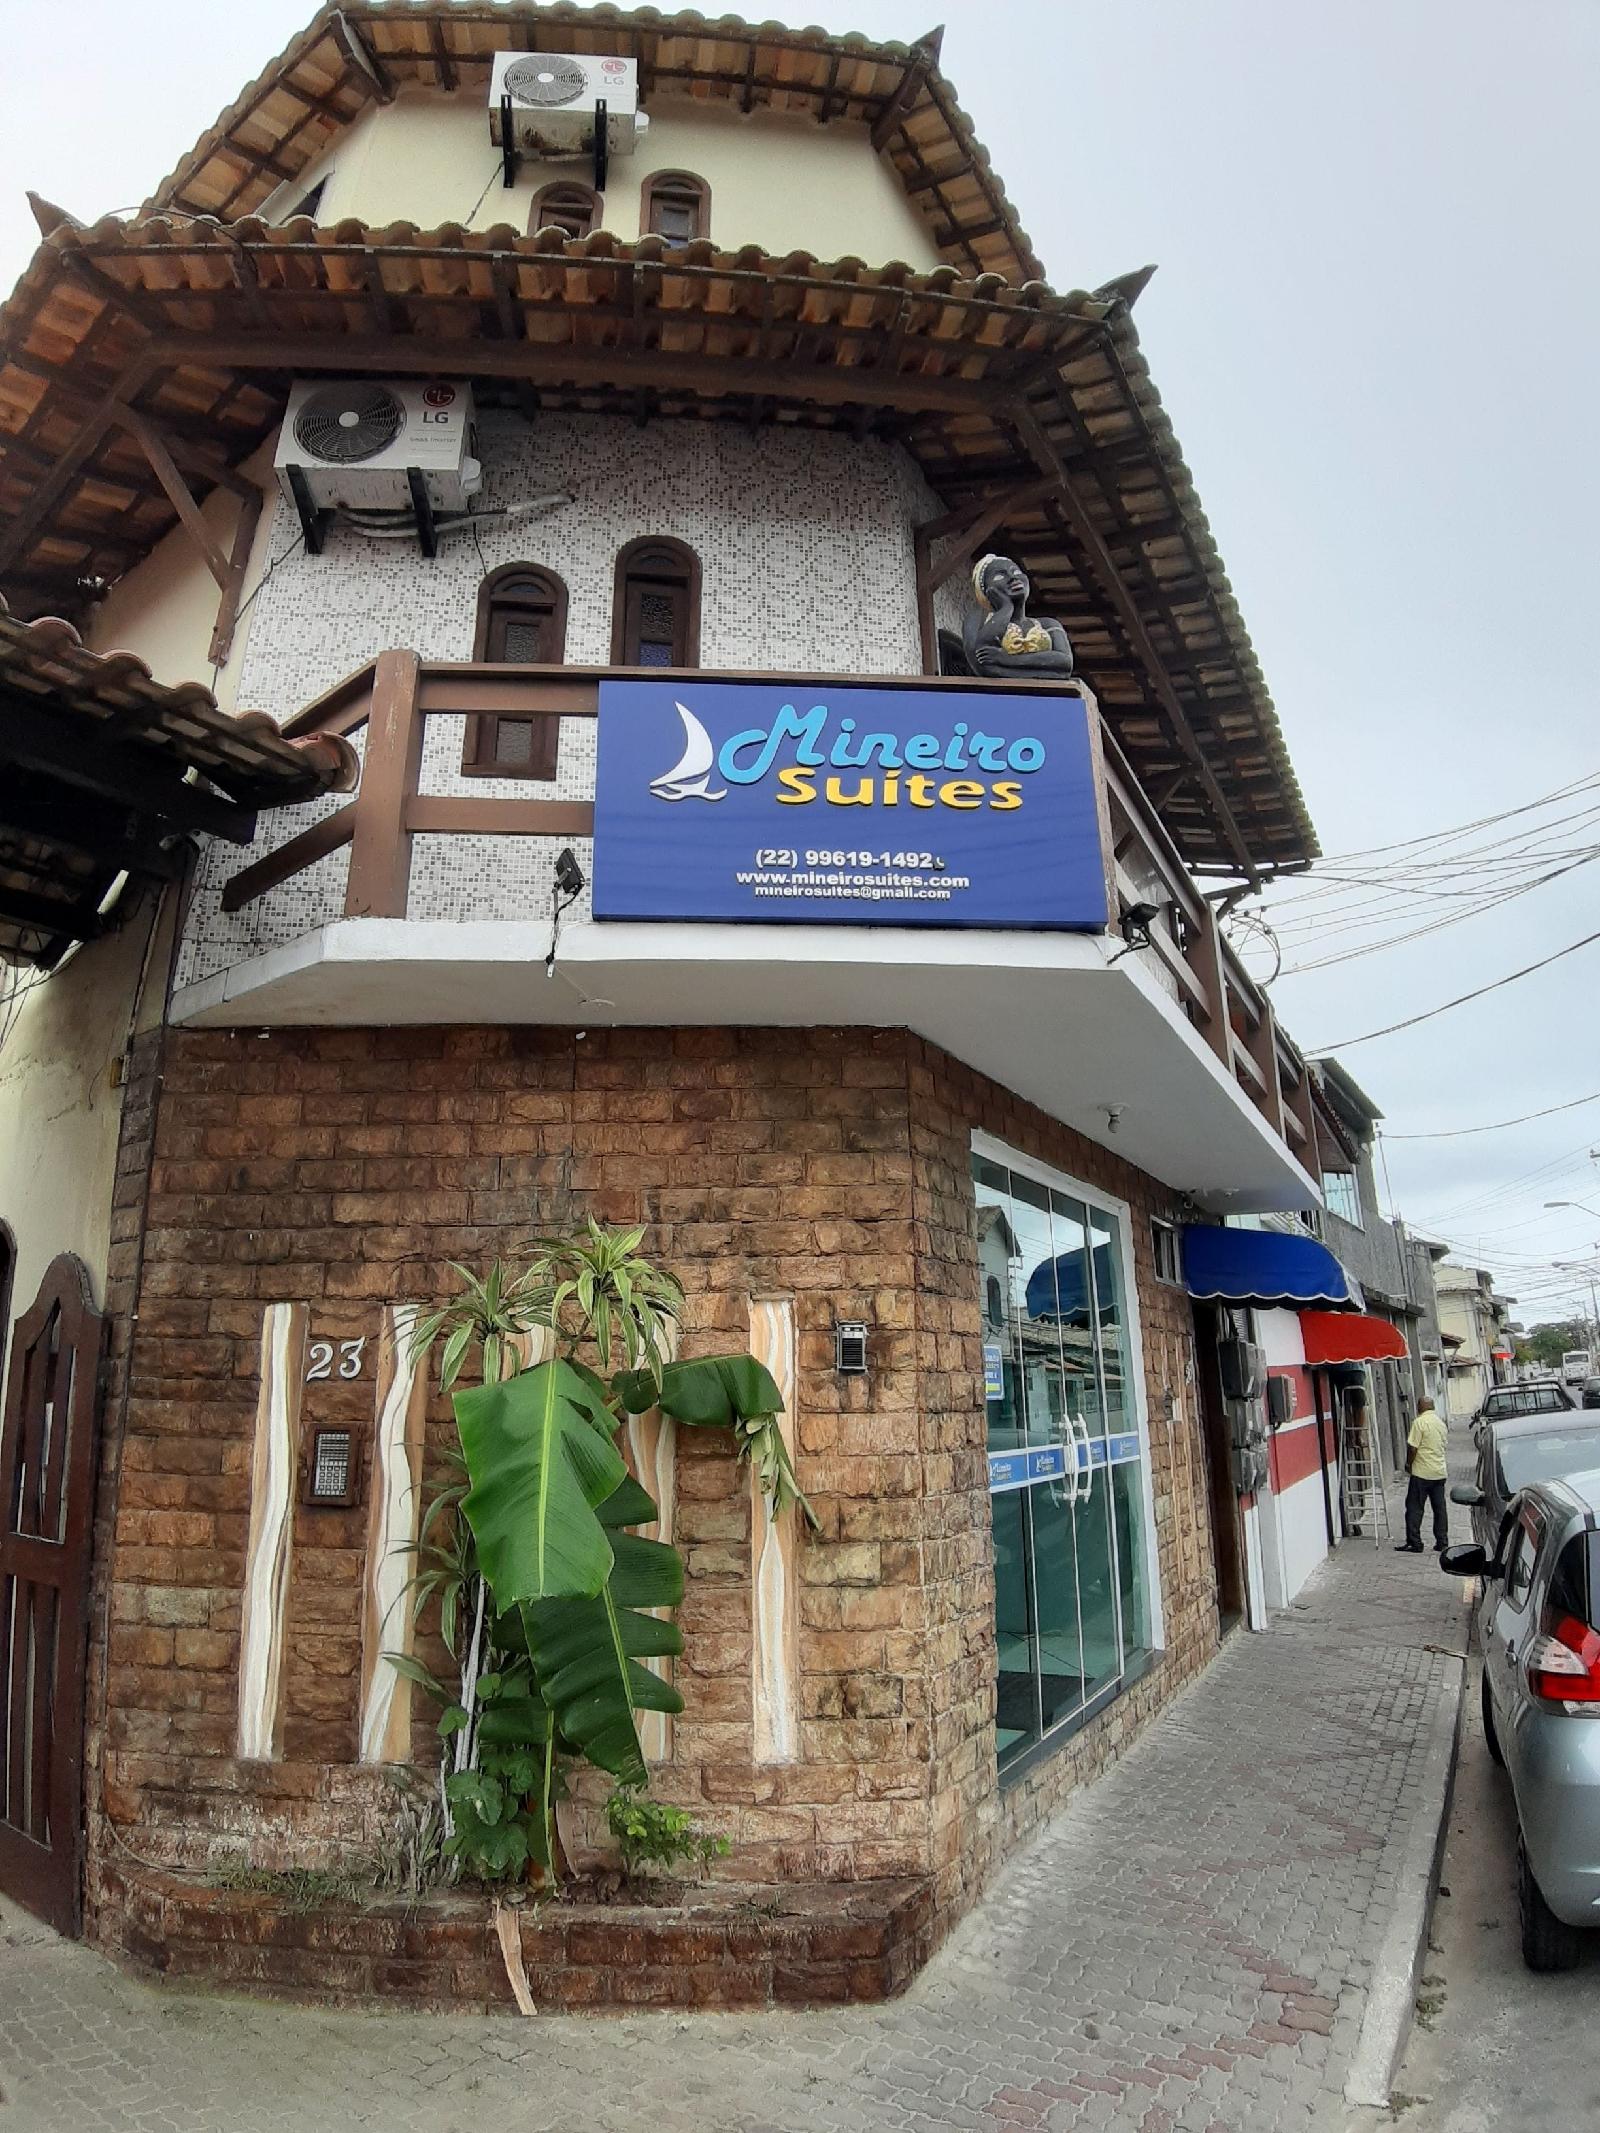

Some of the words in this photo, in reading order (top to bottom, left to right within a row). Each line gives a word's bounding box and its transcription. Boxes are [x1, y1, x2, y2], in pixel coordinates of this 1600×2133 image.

[603, 76, 625, 86] LG
[423, 411, 449, 424] LG
[718, 704, 1046, 785] Mineiro
[756, 849, 798, 869] (22)
[805, 850, 933, 869] 99619-1492
[736, 871, 970, 888] www.mineirosuites.com
[755, 885, 951, 900] mineirosuites@gmail.com
[306, 1336, 366, 1382] 23
